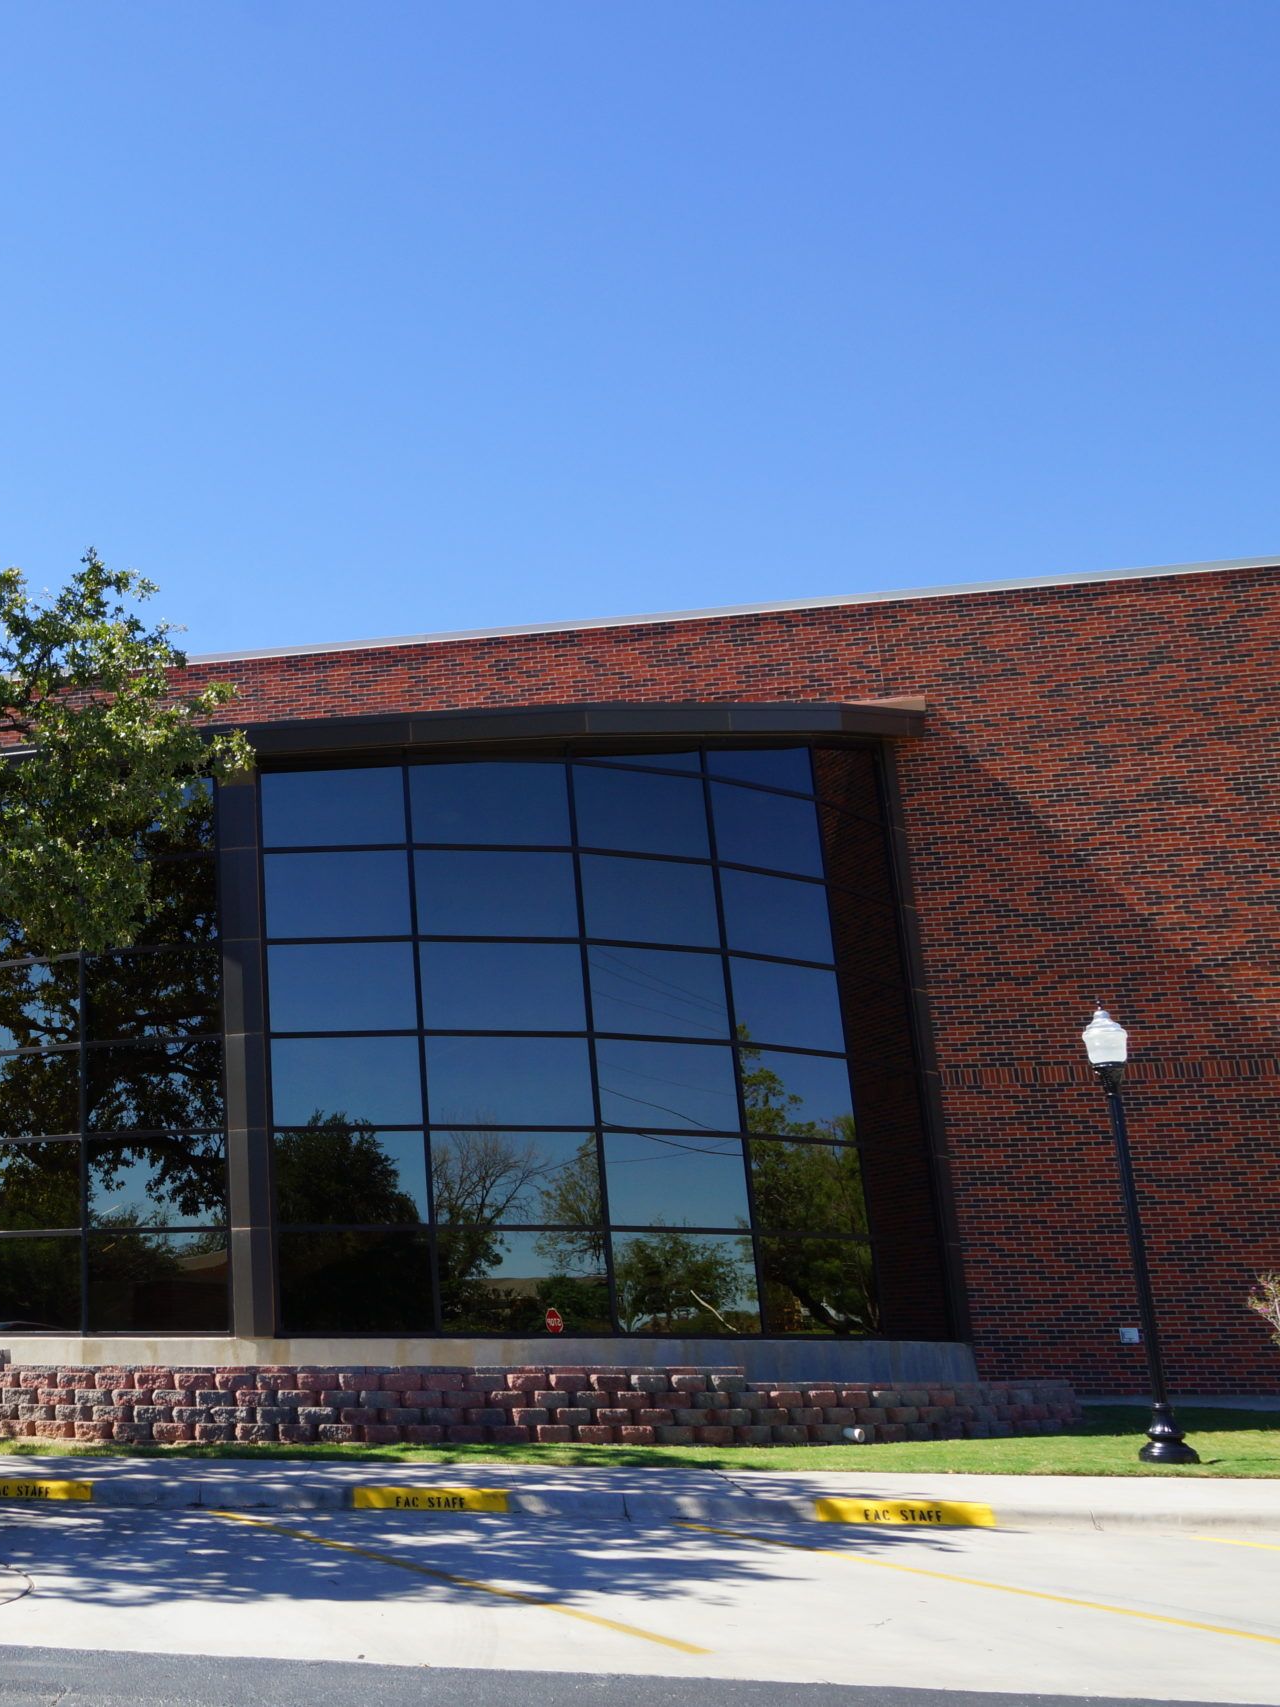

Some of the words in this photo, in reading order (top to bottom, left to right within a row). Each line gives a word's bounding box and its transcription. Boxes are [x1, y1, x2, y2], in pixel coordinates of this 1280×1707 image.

[16, 1486, 51, 1498] STAFF
[396, 1496, 419, 1508] FAC
[428, 1497, 465, 1509] STAFF
[864, 1509, 890, 1521] FAC
[900, 1509, 942, 1522] STAFF
